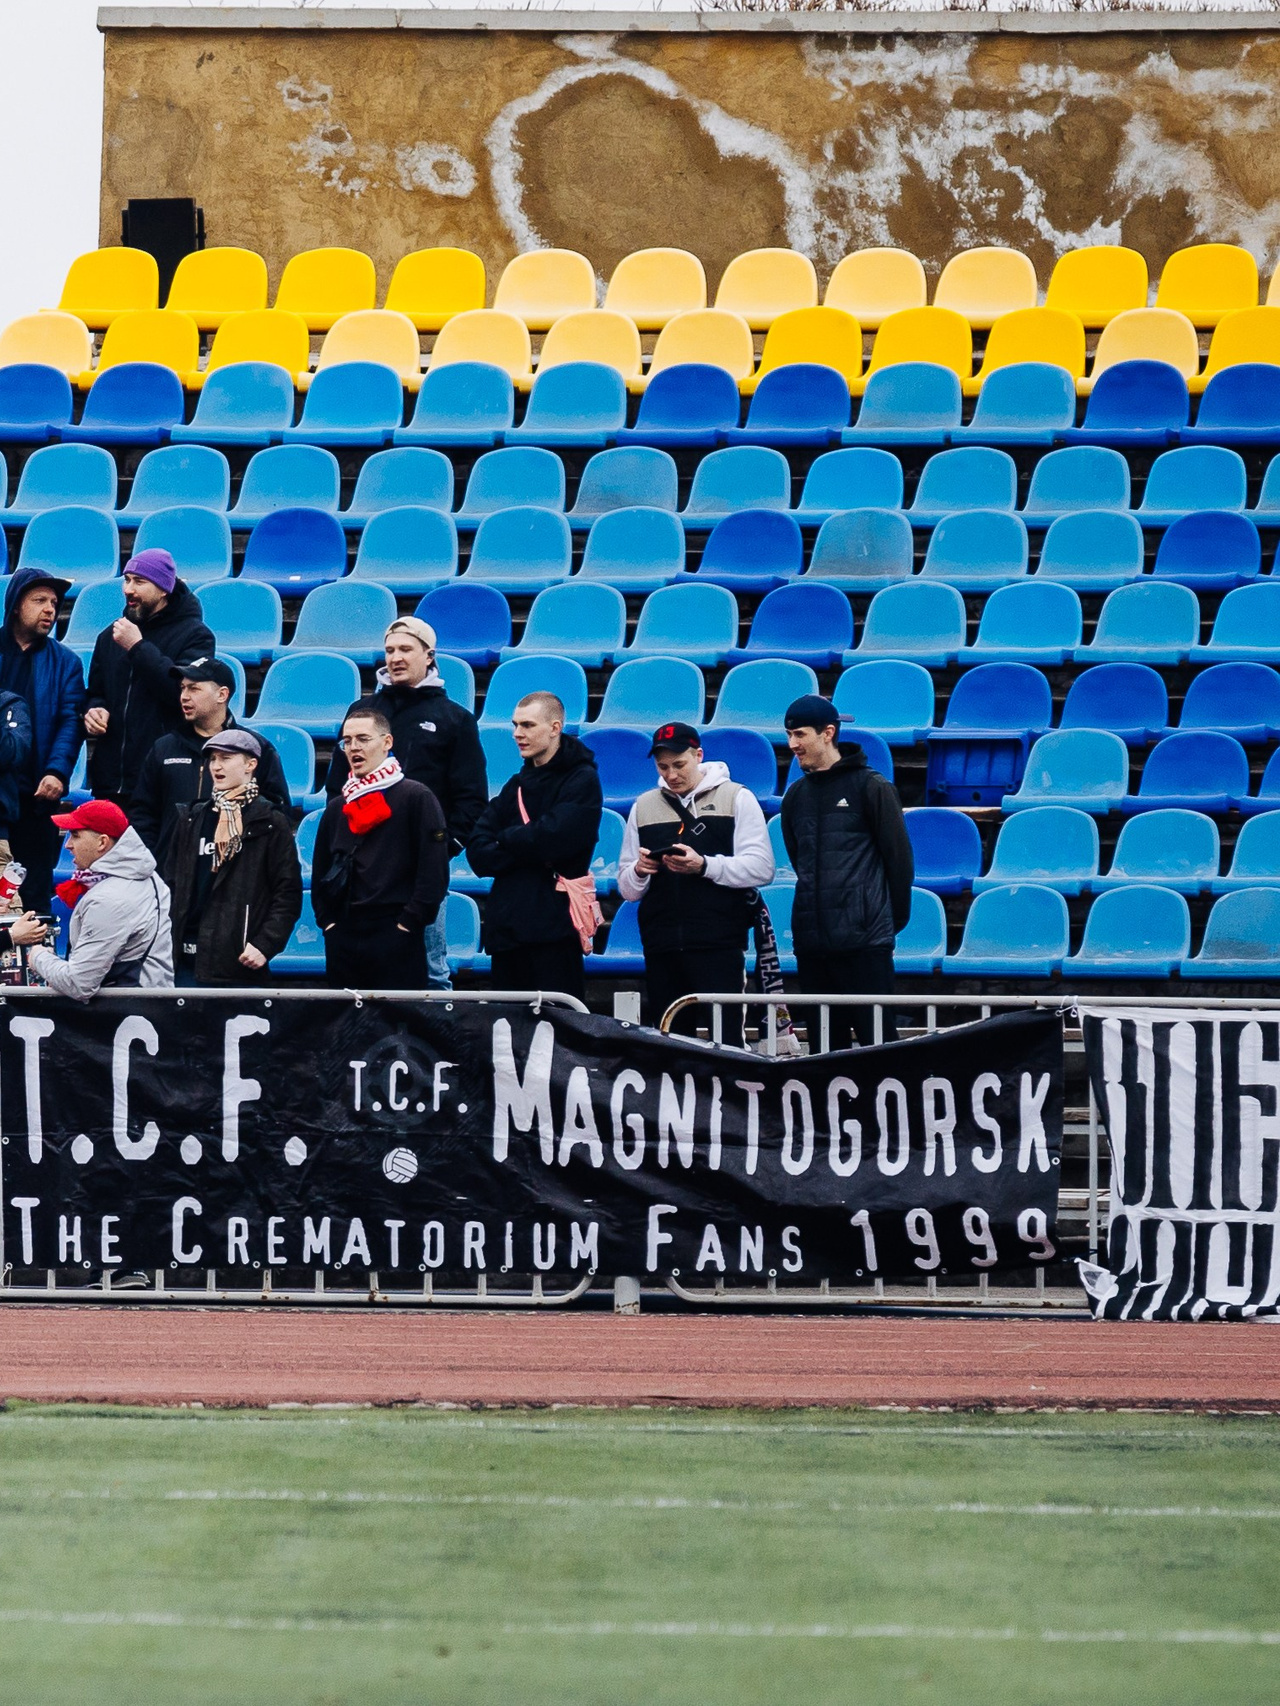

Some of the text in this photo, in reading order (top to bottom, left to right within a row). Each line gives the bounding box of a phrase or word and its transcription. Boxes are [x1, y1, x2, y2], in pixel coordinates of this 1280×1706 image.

[9, 1015, 308, 1166] T.C.F.
[349, 1060, 468, 1113] T.C.F.
[492, 1017, 1051, 1176] MAGNITOGORSK
[850, 1207, 1056, 1272] 1999
